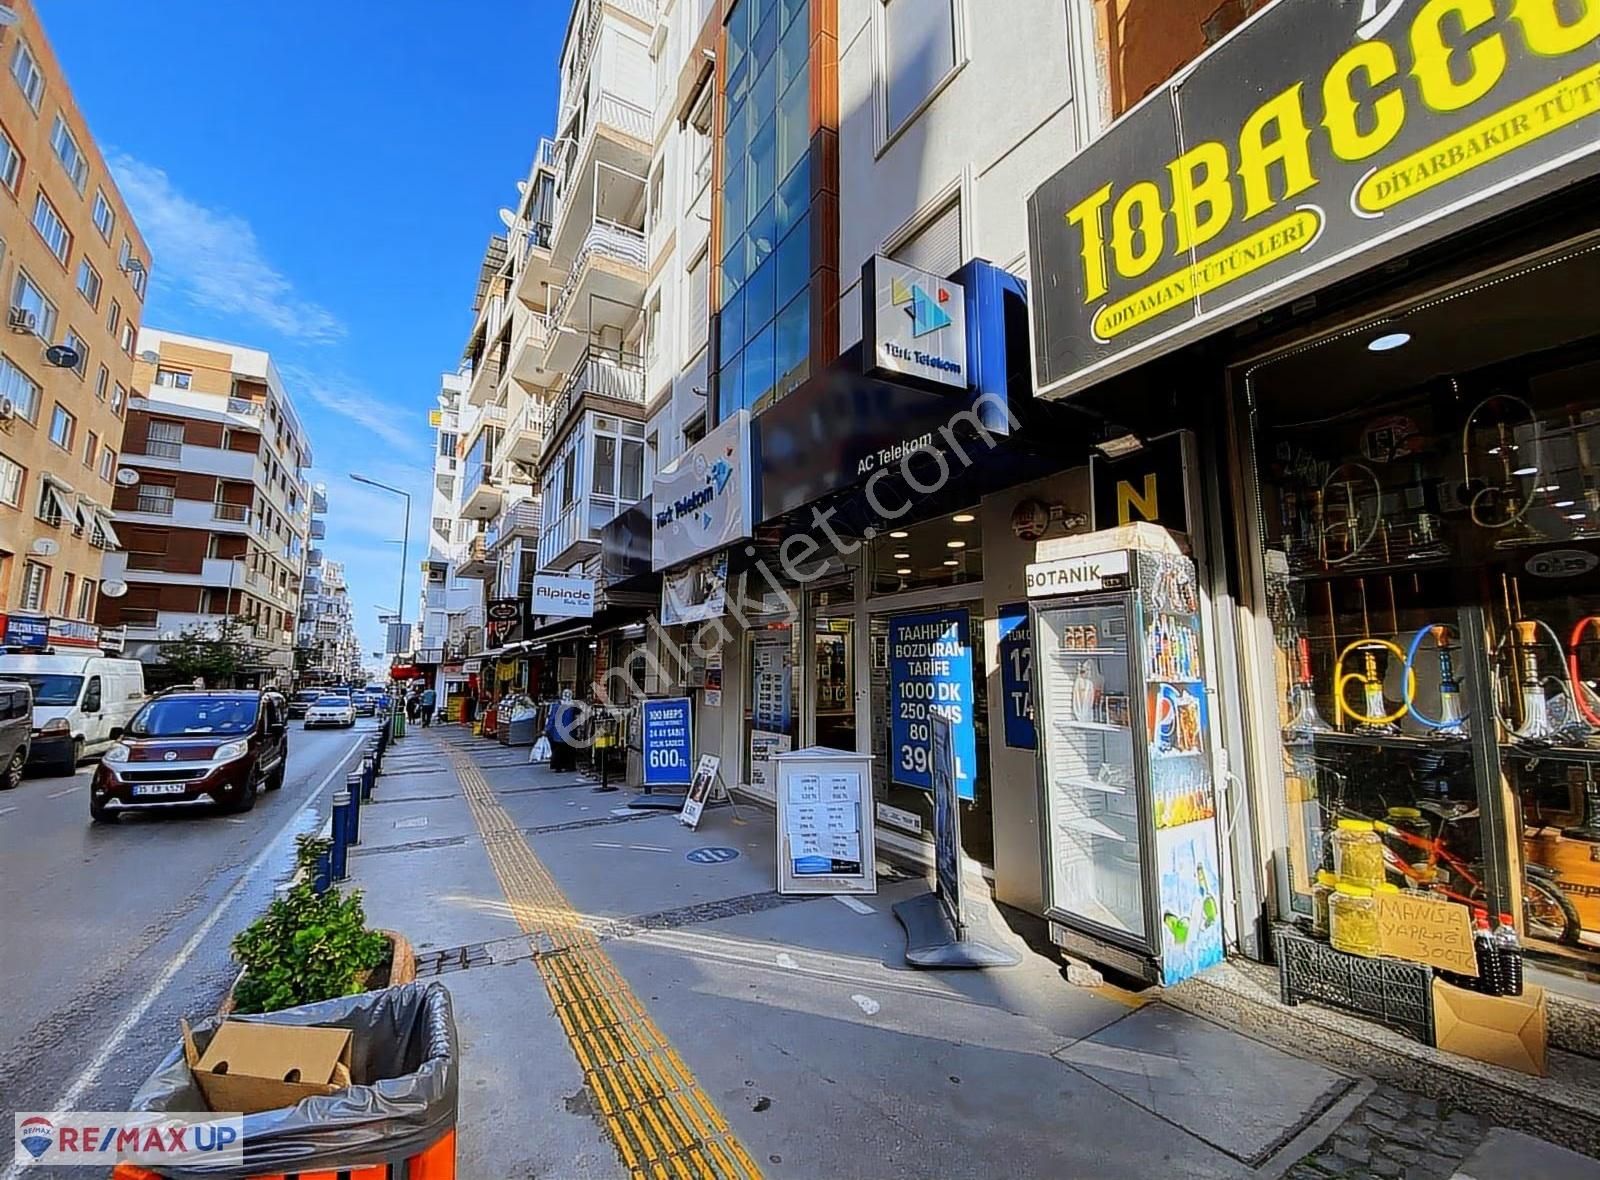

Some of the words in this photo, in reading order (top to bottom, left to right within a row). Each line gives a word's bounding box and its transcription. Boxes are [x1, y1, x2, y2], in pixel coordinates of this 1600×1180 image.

[1375, 113, 1531, 200] DİYARBAKIR
[1535, 70, 1600, 123] TÜT
[1103, 279, 1186, 331] ADIYAMAN
[1189, 217, 1306, 288] TÜTÜNLERİ
[913, 350, 962, 375] Telekom
[857, 455, 874, 475] AC
[877, 432, 932, 466] Telekom
[674, 485, 714, 519] Telekom
[1027, 561, 1101, 588] BOTANİK
[898, 619, 958, 641] TAAHHÜT
[895, 641, 965, 658] BOZDURAN
[908, 658, 950, 676] TARİFE
[899, 682, 935, 700] 1000
[938, 682, 962, 701] DK
[900, 703, 926, 720] 250
[910, 724, 928, 741] 80
[902, 745, 933, 774] 39
